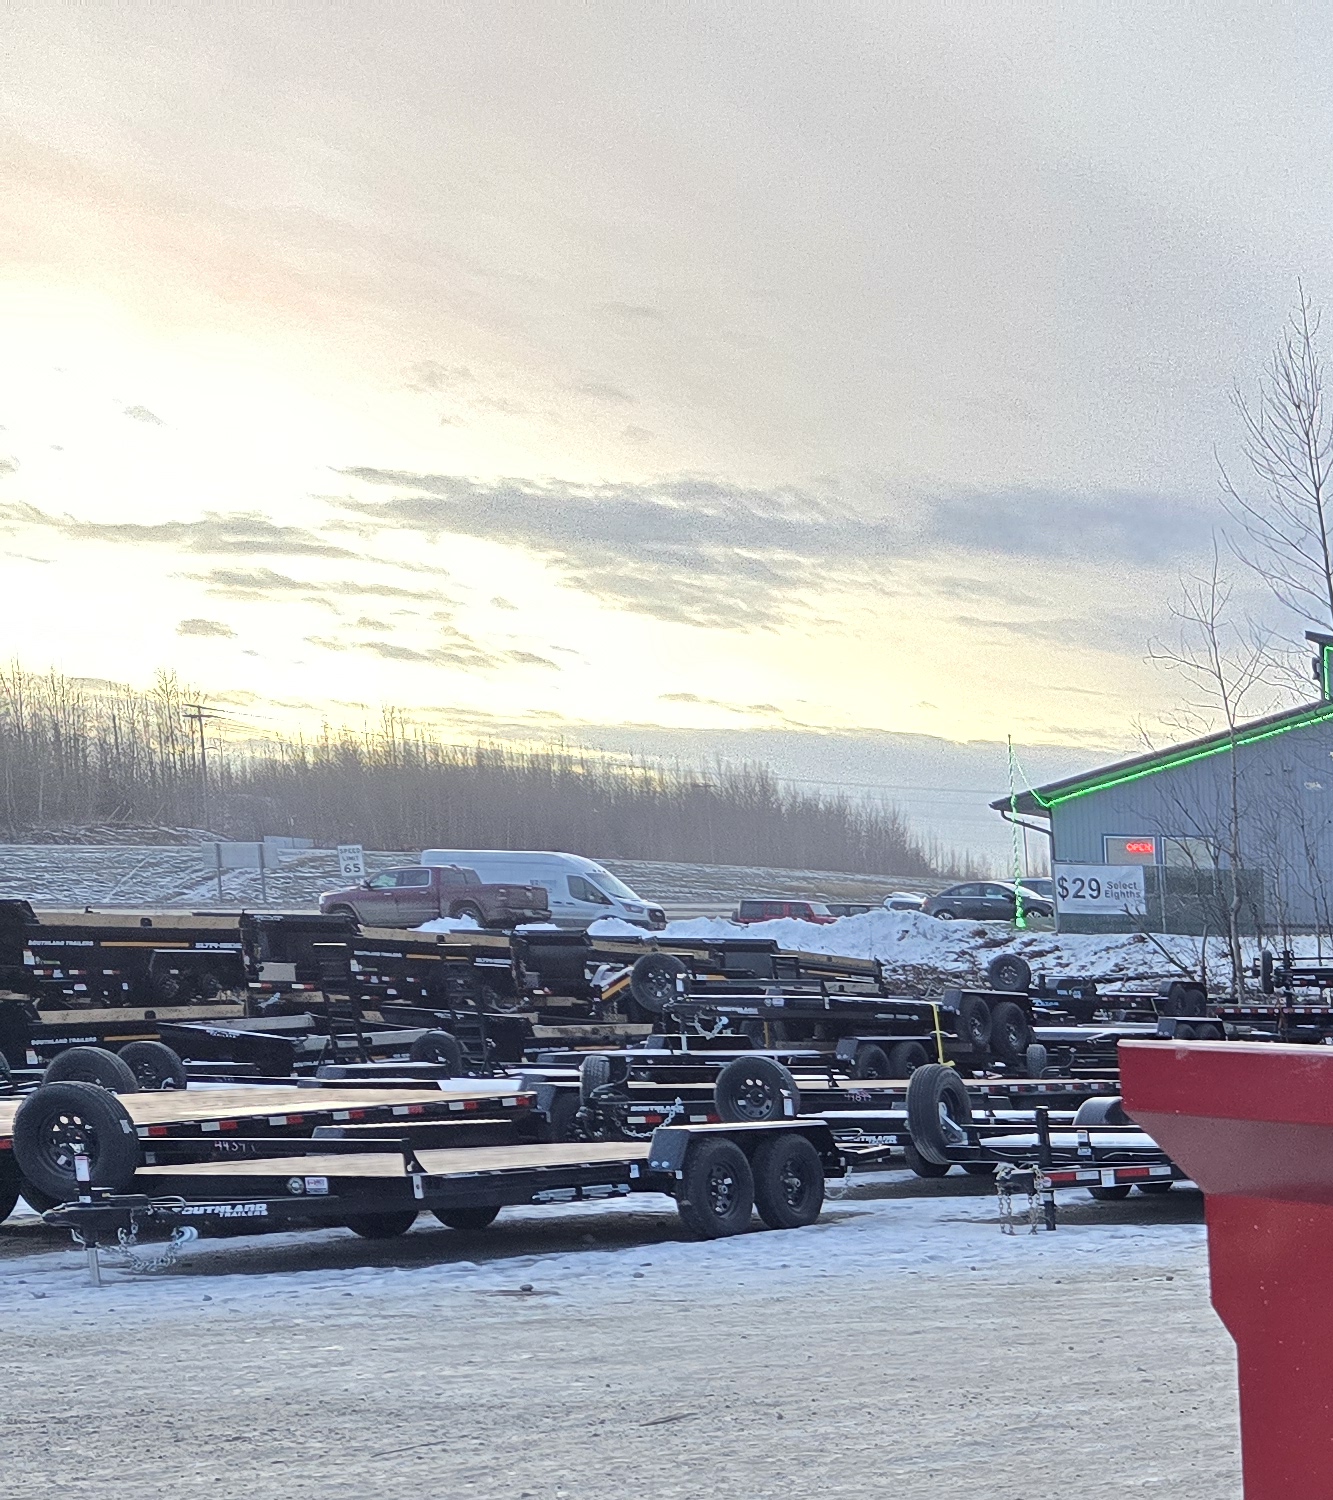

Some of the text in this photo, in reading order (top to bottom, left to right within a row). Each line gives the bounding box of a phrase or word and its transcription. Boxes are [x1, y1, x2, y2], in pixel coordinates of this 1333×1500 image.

[1126, 842, 1153, 852] OPEN
[344, 863, 361, 873] 65
[1058, 875, 1101, 901] $29
[1106, 881, 1138, 890] Select
[1104, 889, 1141, 900] Eighths
